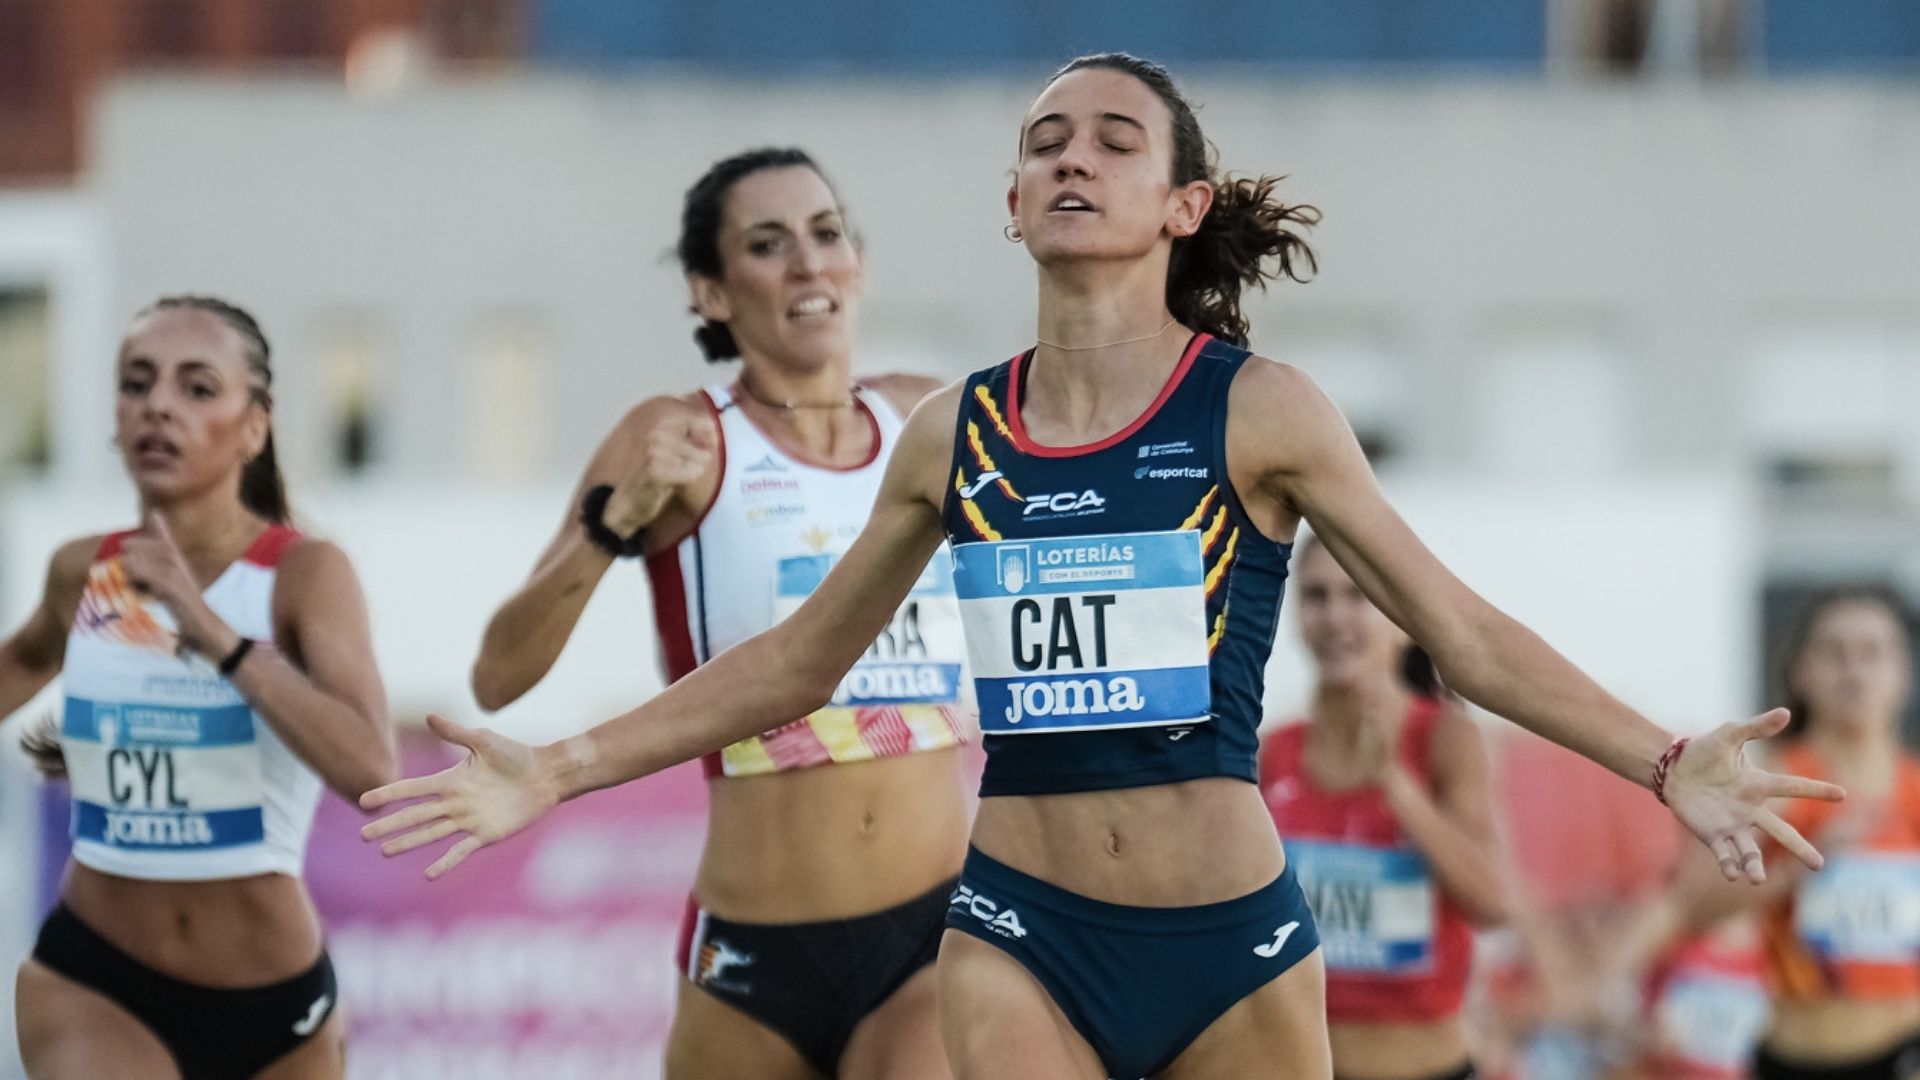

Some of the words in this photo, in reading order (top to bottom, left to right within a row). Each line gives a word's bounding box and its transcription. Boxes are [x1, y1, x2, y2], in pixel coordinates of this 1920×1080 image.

[1149, 467, 1208, 480] esportcat
[1023, 489, 1106, 515] FCA
[1037, 543, 1135, 565] LOTERÍAS
[1083, 569, 1123, 578] DEPORTE
[868, 601, 927, 658] RA
[1011, 595, 1115, 671] CAT
[107, 748, 189, 809] CYL
[950, 885, 1027, 938] FCA
